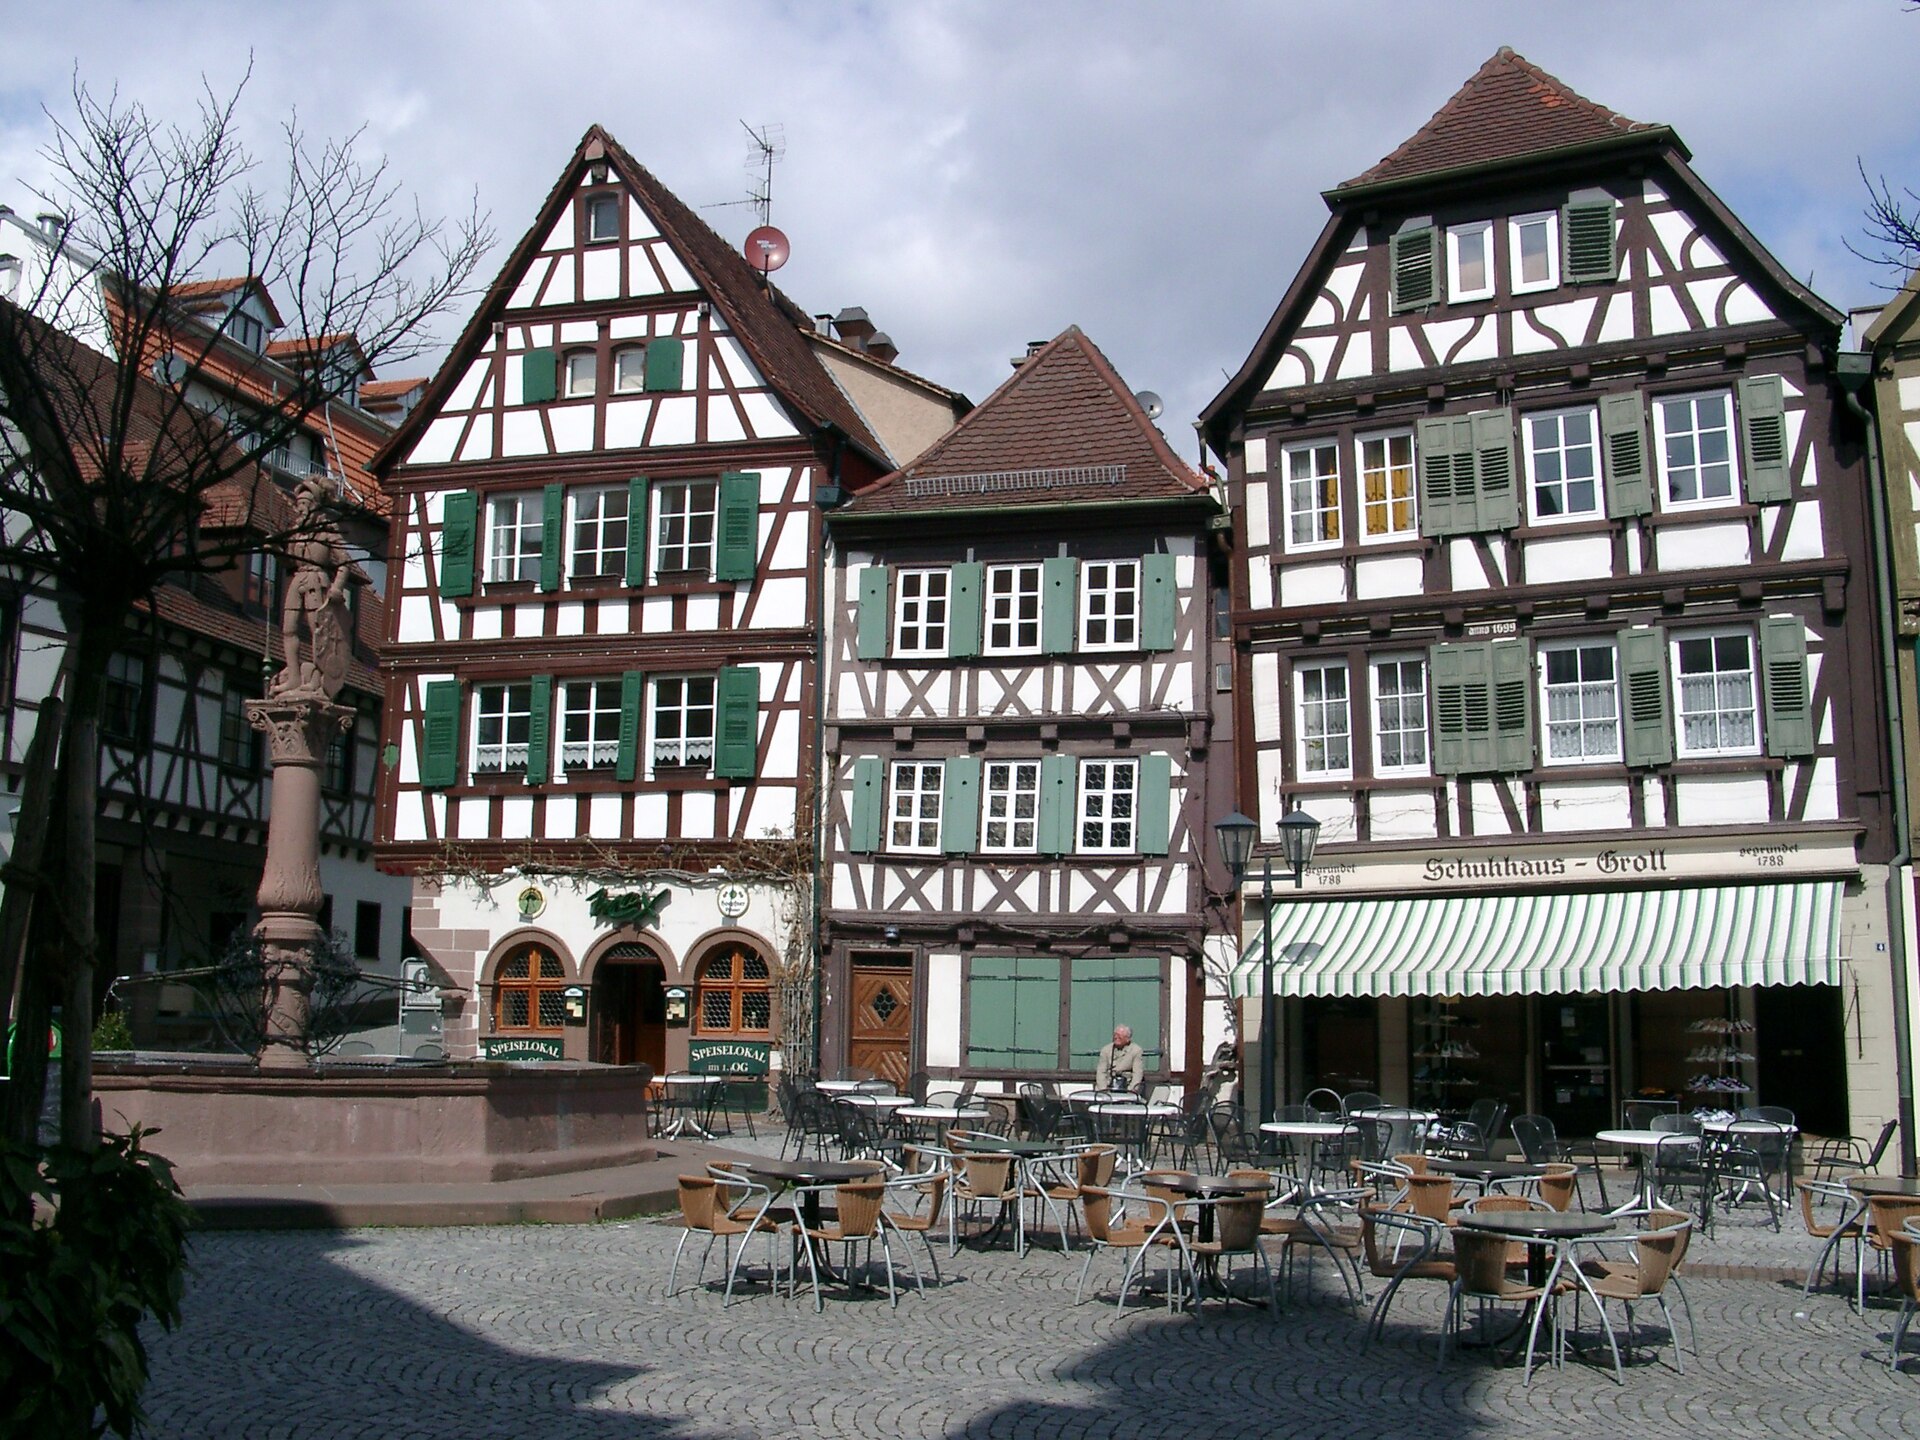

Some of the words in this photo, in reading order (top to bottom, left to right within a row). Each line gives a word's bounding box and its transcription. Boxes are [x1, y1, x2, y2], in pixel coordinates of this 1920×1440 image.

[1468, 626, 1490, 635] anno
[1492, 623, 1516, 634] 1699
[1423, 856, 1565, 881] Schuhhaus
[1596, 847, 1668, 874] Groll
[1757, 855, 1784, 867] 1788
[1318, 875, 1341, 886] 1788
[490, 1041, 559, 1058] SPEISELOKAL
[691, 1045, 766, 1064] SPEISELOKAL
